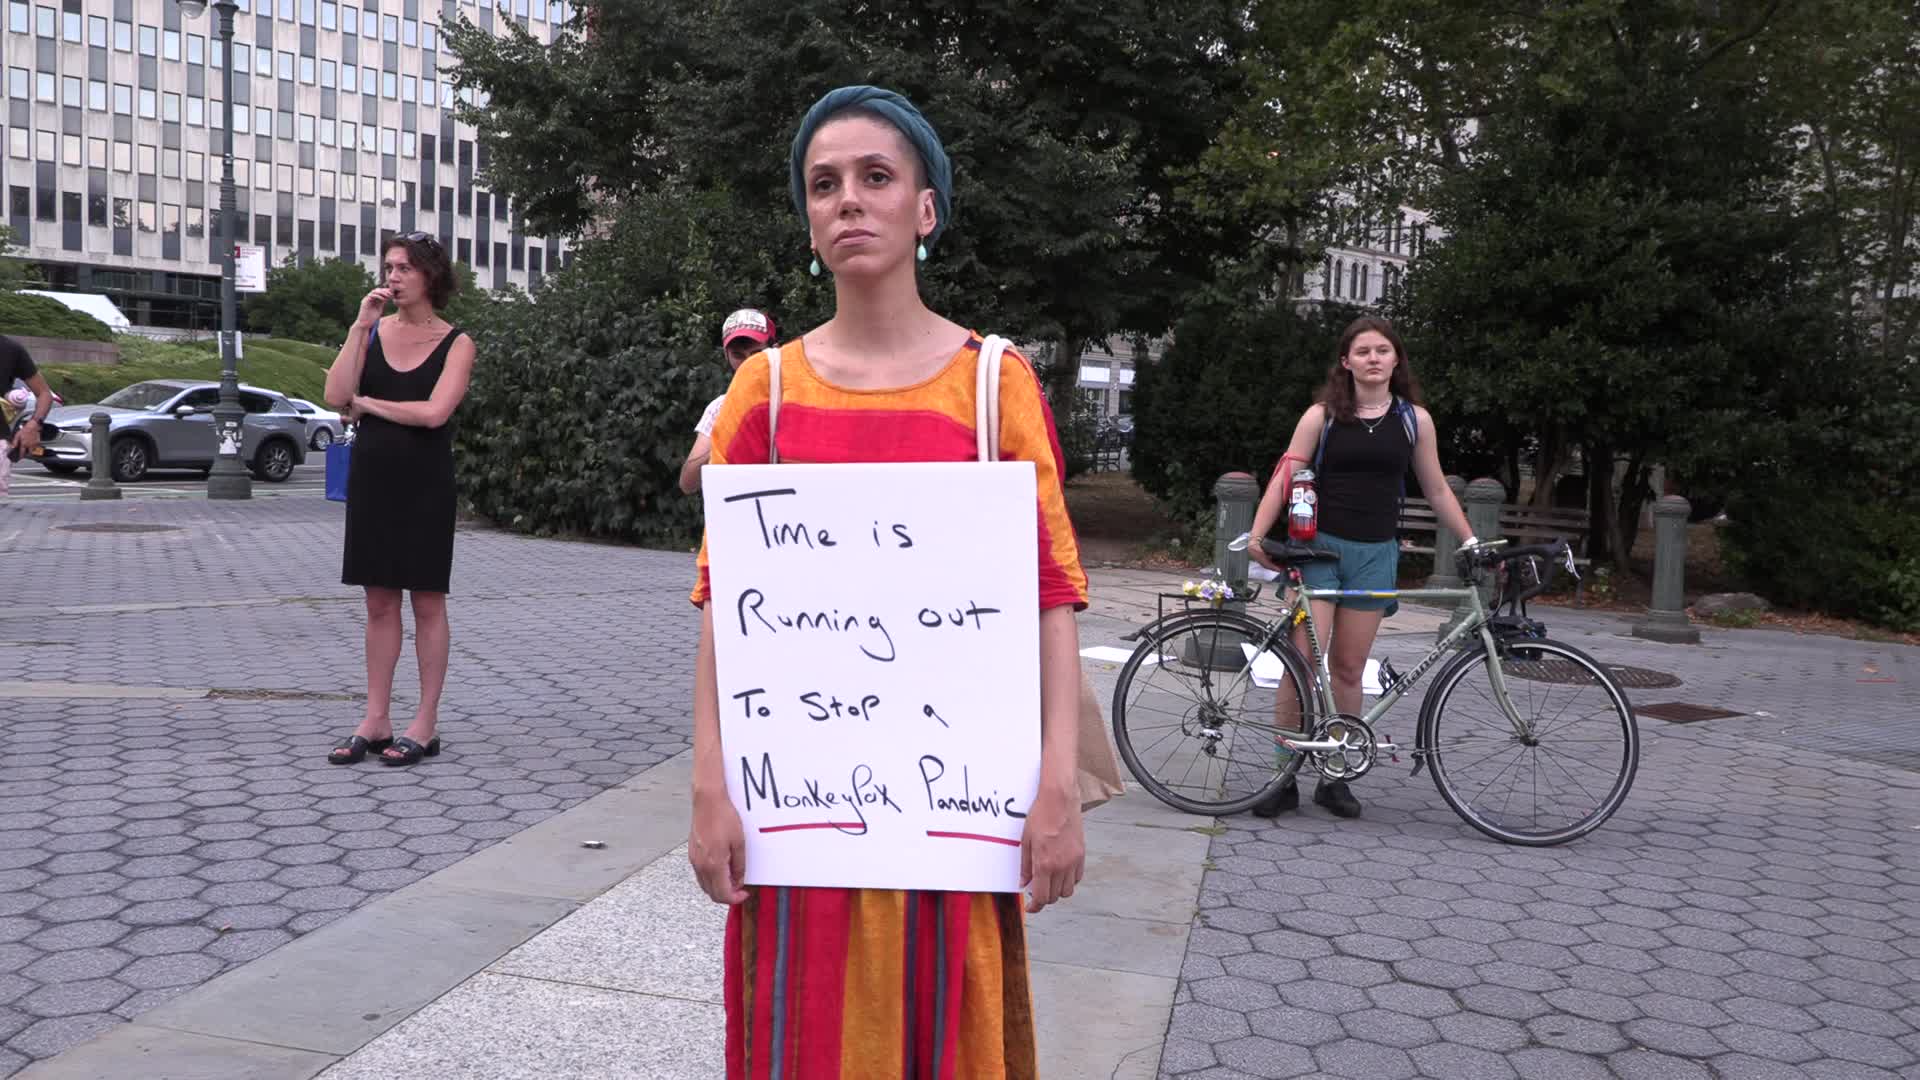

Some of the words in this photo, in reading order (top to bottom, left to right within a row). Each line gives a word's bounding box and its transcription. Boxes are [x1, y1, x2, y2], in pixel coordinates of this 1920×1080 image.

[724, 488, 837, 549] Time
[873, 520, 913, 548] is
[737, 588, 896, 662] Running
[917, 600, 1001, 630] out
[1394, 637, 1454, 695] Bianchi
[732, 687, 771, 719] To
[799, 691, 881, 722] Stop
[923, 703, 949, 729] a
[741, 752, 902, 836] Monkeypox
[918, 754, 1027, 819] Pandemic
